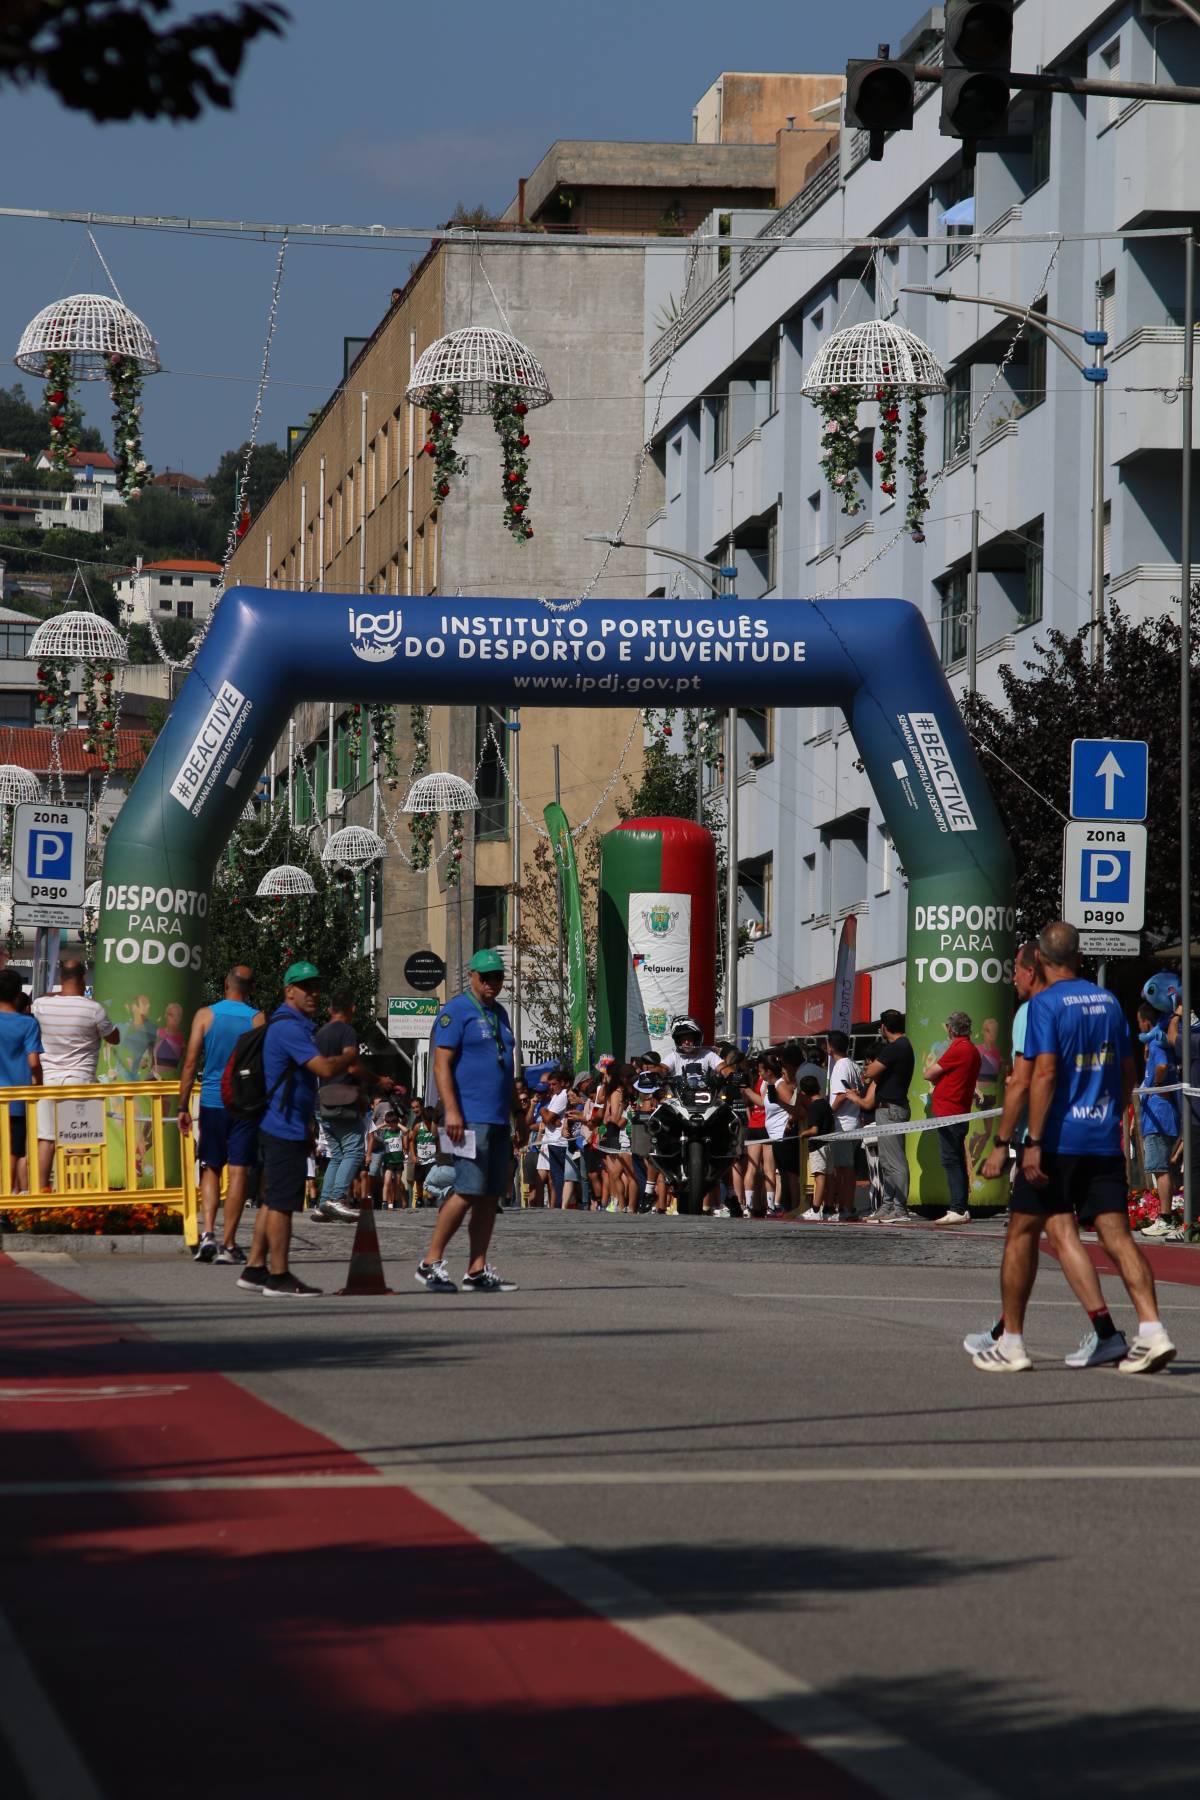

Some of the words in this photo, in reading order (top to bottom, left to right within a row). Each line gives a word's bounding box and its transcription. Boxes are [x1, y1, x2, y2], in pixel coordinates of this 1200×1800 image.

[349, 608, 402, 642] ipdj
[441, 616, 588, 637] INSTITUTO
[601, 615, 769, 638] PORTUGUÊS
[405, 636, 446, 658] DO
[458, 638, 605, 661] DESPORTO
[619, 641, 632, 661] E
[644, 641, 806, 662] JUVENTUDE
[513, 674, 701, 693] www.ipdj.gov.pt
[177, 688, 239, 799] #BEACTIVE
[191, 784, 211, 818] SEMANA
[207, 753, 229, 787] EUROPEIA
[232, 700, 253, 742] DESPORTO
[916, 718, 971, 825] #BEACTIVE
[897, 714, 915, 745] SEMANA
[909, 742, 928, 783] EUROPEIA
[923, 781, 933, 794] DO
[928, 794, 948, 832] DESPORTO
[34, 812, 69, 825] zona
[1086, 830, 1126, 842] zona
[35, 834, 64, 875] P
[1089, 853, 1121, 899] P
[31, 885, 68, 899] pago
[105, 885, 207, 918] DESPORTO
[128, 914, 183, 935] PARA
[915, 905, 1014, 932] DESPORTO
[1084, 910, 1125, 924] pago
[103, 938, 202, 970] TODOS
[940, 934, 994, 951] PARA
[643, 965, 684, 974] Felgueiras
[915, 957, 1013, 984] TODOS
[390, 1000, 417, 1010] EURO
[59, 1131, 103, 1140] Felgueiras
